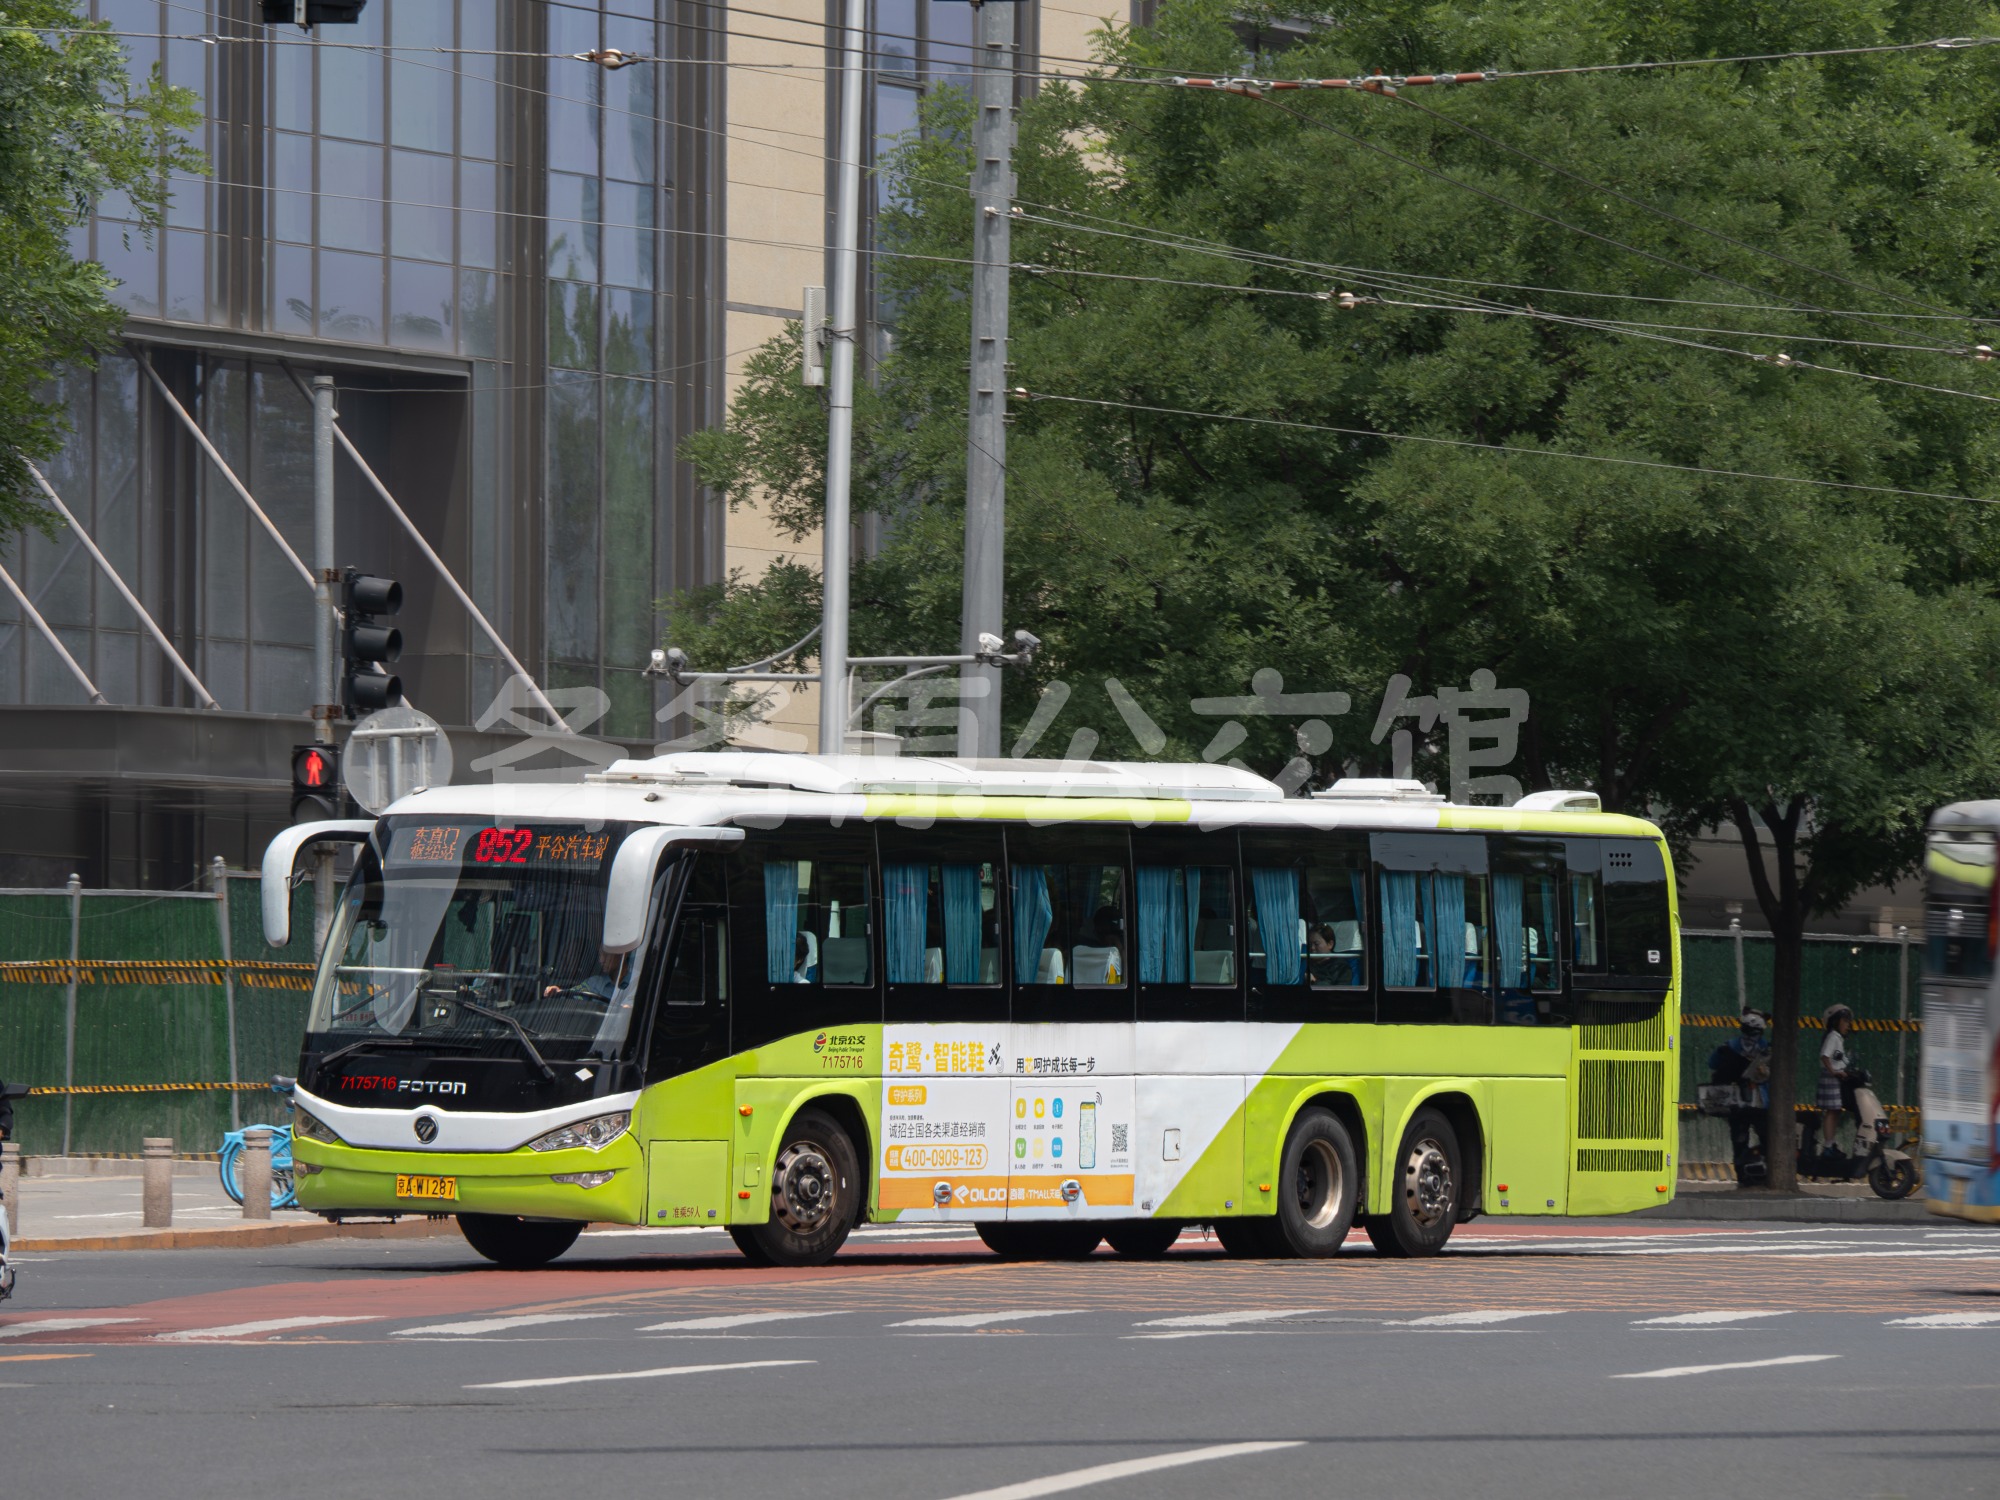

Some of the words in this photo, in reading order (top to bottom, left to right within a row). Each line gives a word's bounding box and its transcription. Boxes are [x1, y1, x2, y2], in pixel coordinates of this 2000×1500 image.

[413, 827, 461, 844] 东直门
[475, 828, 533, 863] 852
[829, 1035, 866, 1046] 北京公交
[822, 1055, 863, 1069] 7175716
[1015, 1056, 1096, 1074] 用芯呵护成长每一步
[341, 1076, 396, 1090] 7175716
[398, 1080, 467, 1095] FOTON
[893, 1088, 923, 1103] 守护系列
[889, 1121, 986, 1139] 诚招全国各类渠道经销商
[905, 1149, 982, 1166] 400-0909-123
[672, 1206, 701, 1219] 准乘59人
